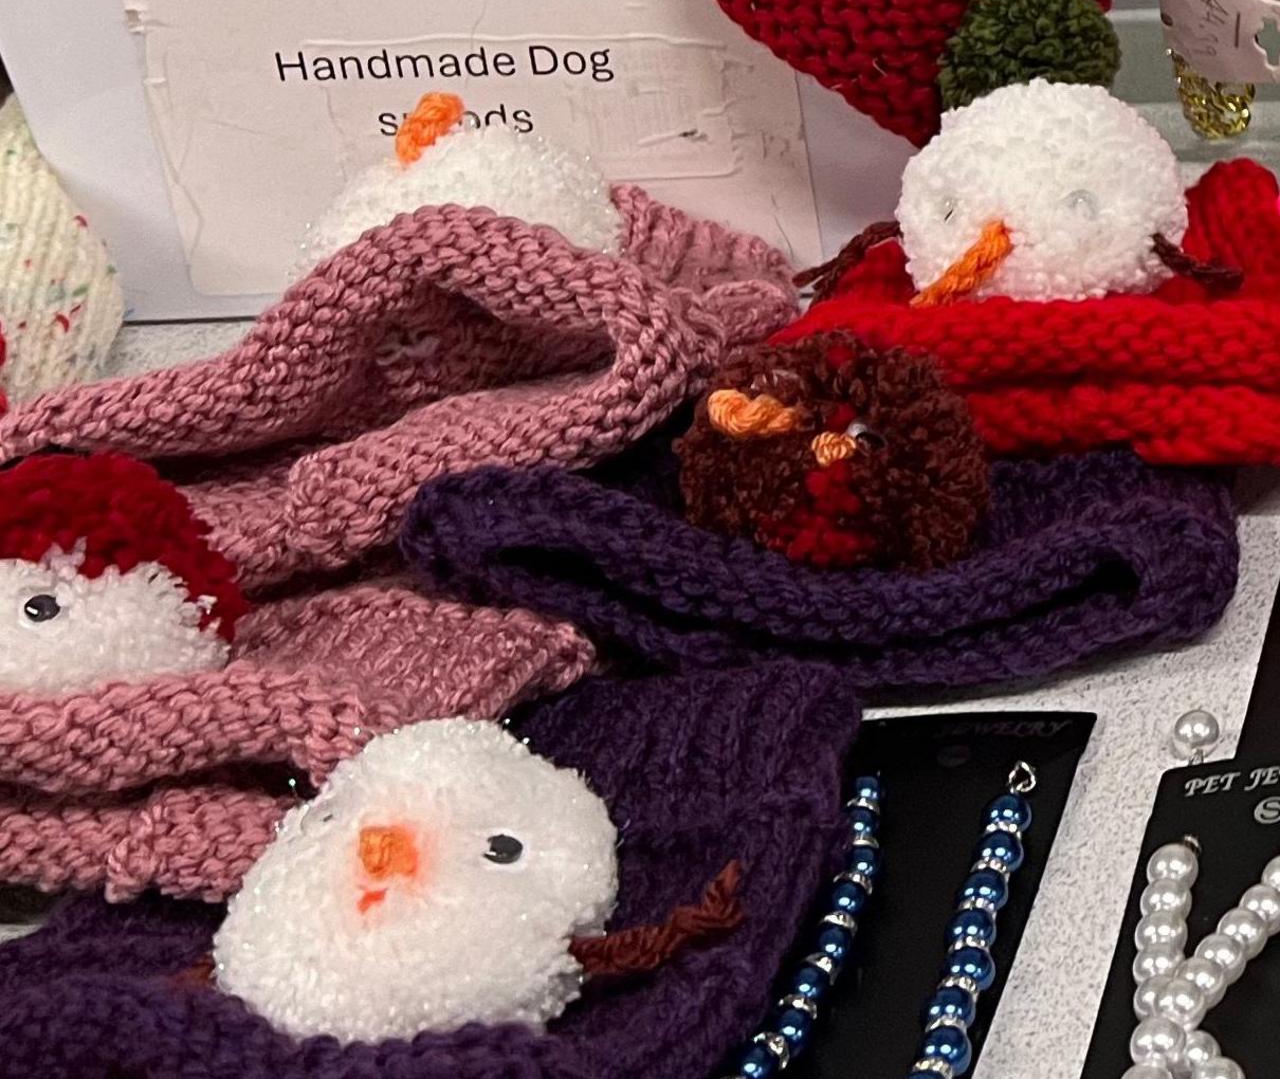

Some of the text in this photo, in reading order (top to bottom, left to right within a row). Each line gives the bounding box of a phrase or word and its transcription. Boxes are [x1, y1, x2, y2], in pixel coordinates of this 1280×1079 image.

[275, 44, 614, 82] Handmade Dog
[1184, 772, 1241, 797] PET
